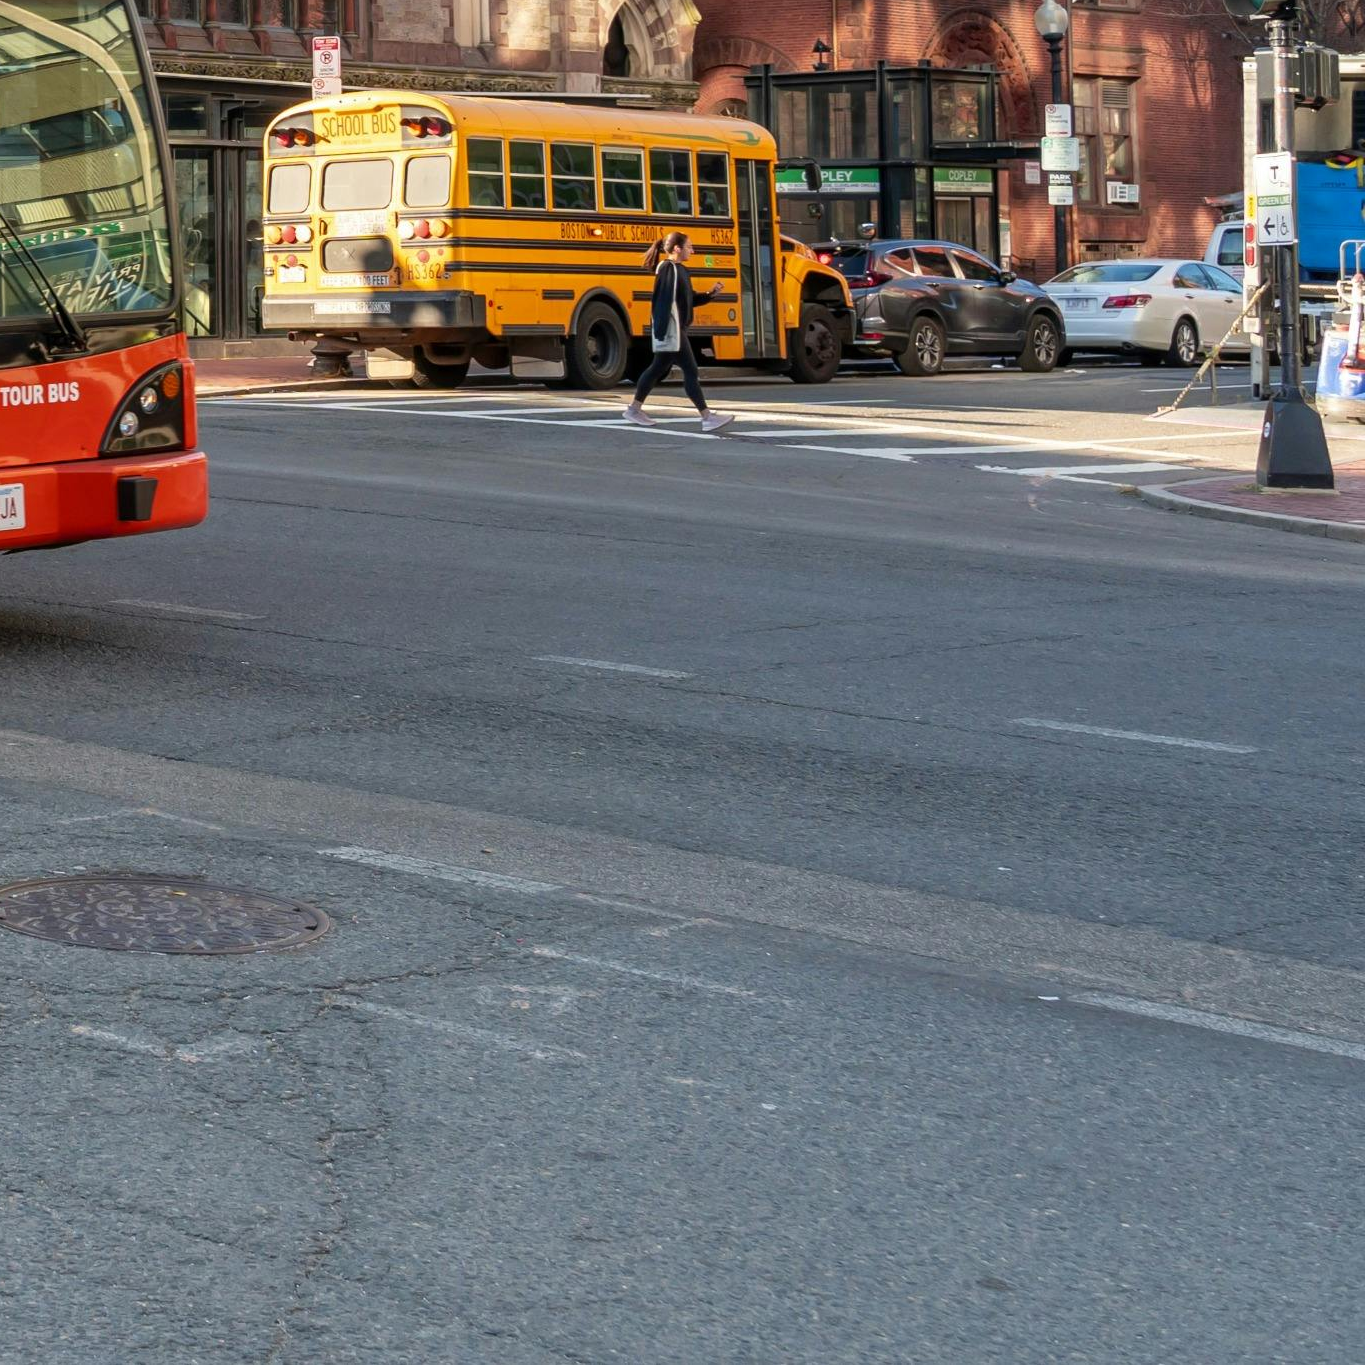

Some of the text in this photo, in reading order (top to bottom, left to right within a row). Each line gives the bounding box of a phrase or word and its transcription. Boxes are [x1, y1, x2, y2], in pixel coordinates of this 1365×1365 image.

[321, 113, 396, 138] SCHOOL BUS
[801, 171, 853, 181] CPLEY
[949, 170, 977, 181] COPLEY
[560, 223, 664, 242] BOSTON PUBLIC SCHOOLS
[710, 228, 734, 245] HS362
[406, 262, 442, 280] HS362
[372, 275, 389, 285] FEET
[0, 385, 44, 407] TOUR
[47, 382, 80, 403] BUS
